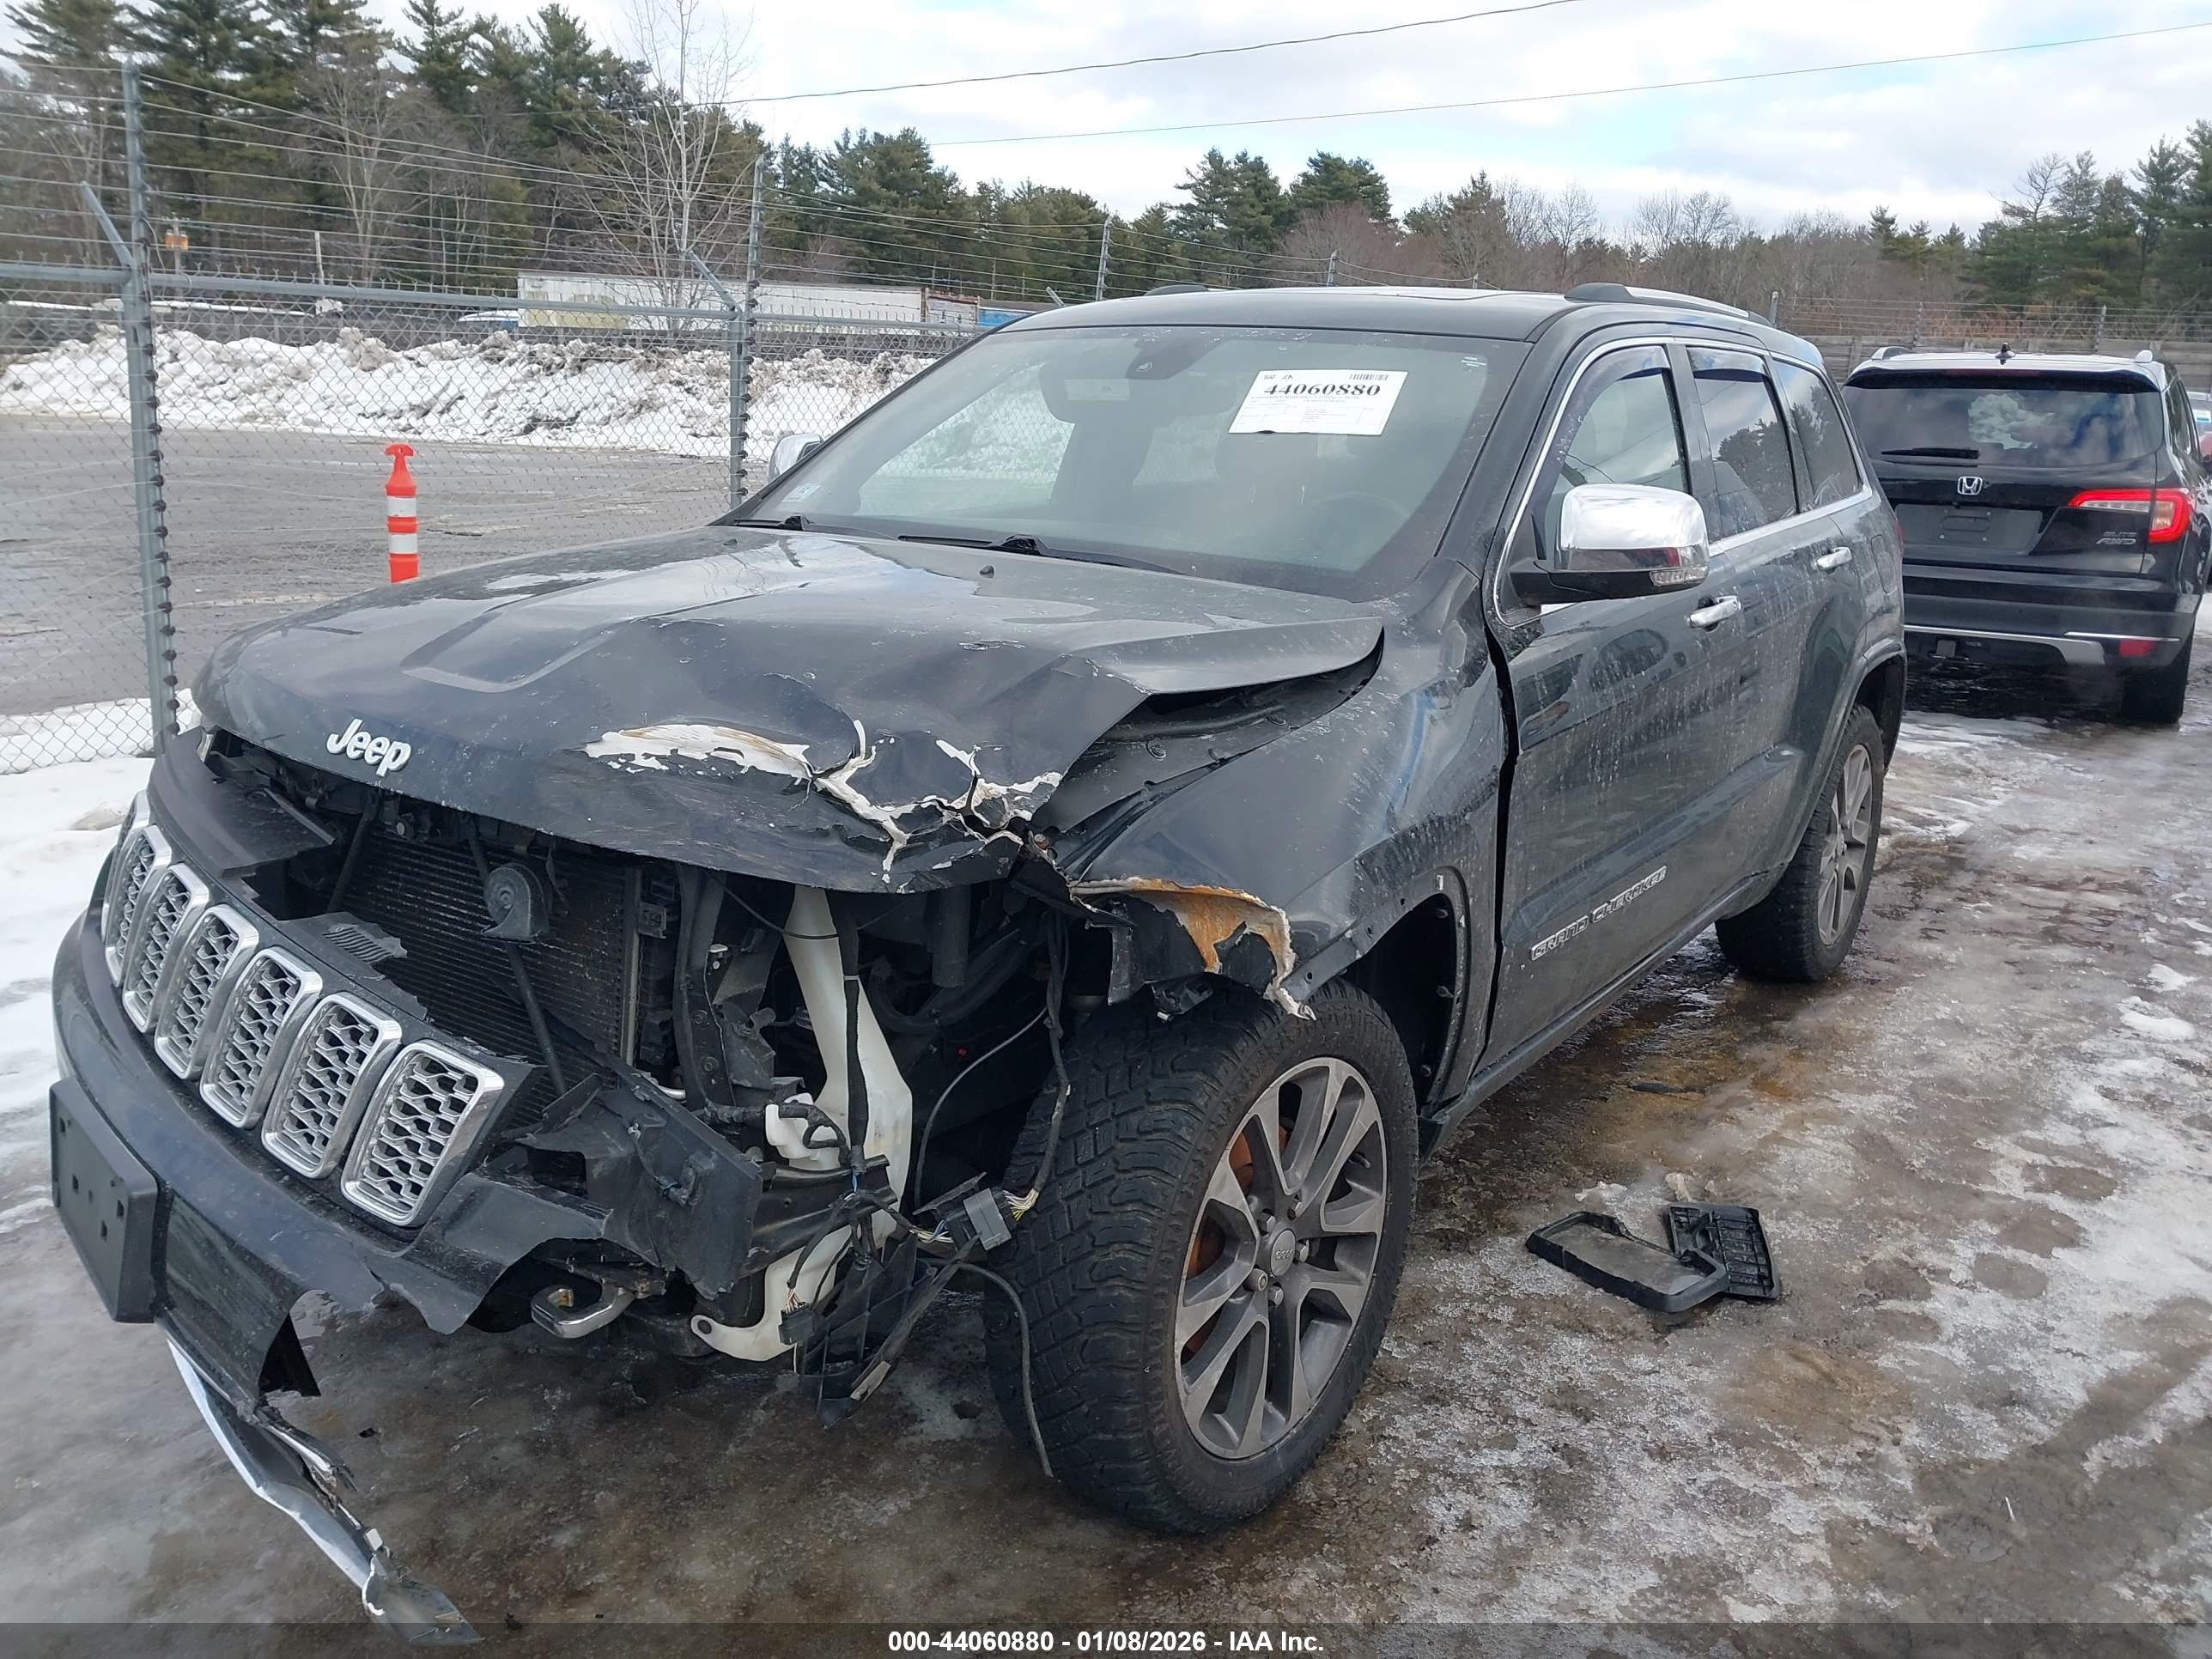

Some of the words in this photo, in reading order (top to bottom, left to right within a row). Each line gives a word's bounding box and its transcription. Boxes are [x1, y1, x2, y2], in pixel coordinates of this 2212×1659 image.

[1264, 383, 1381, 396] 44060880
[326, 718, 411, 777] Jeep
[1531, 915, 1589, 961] GRAND
[1592, 865, 1667, 923] CHEROKEE
